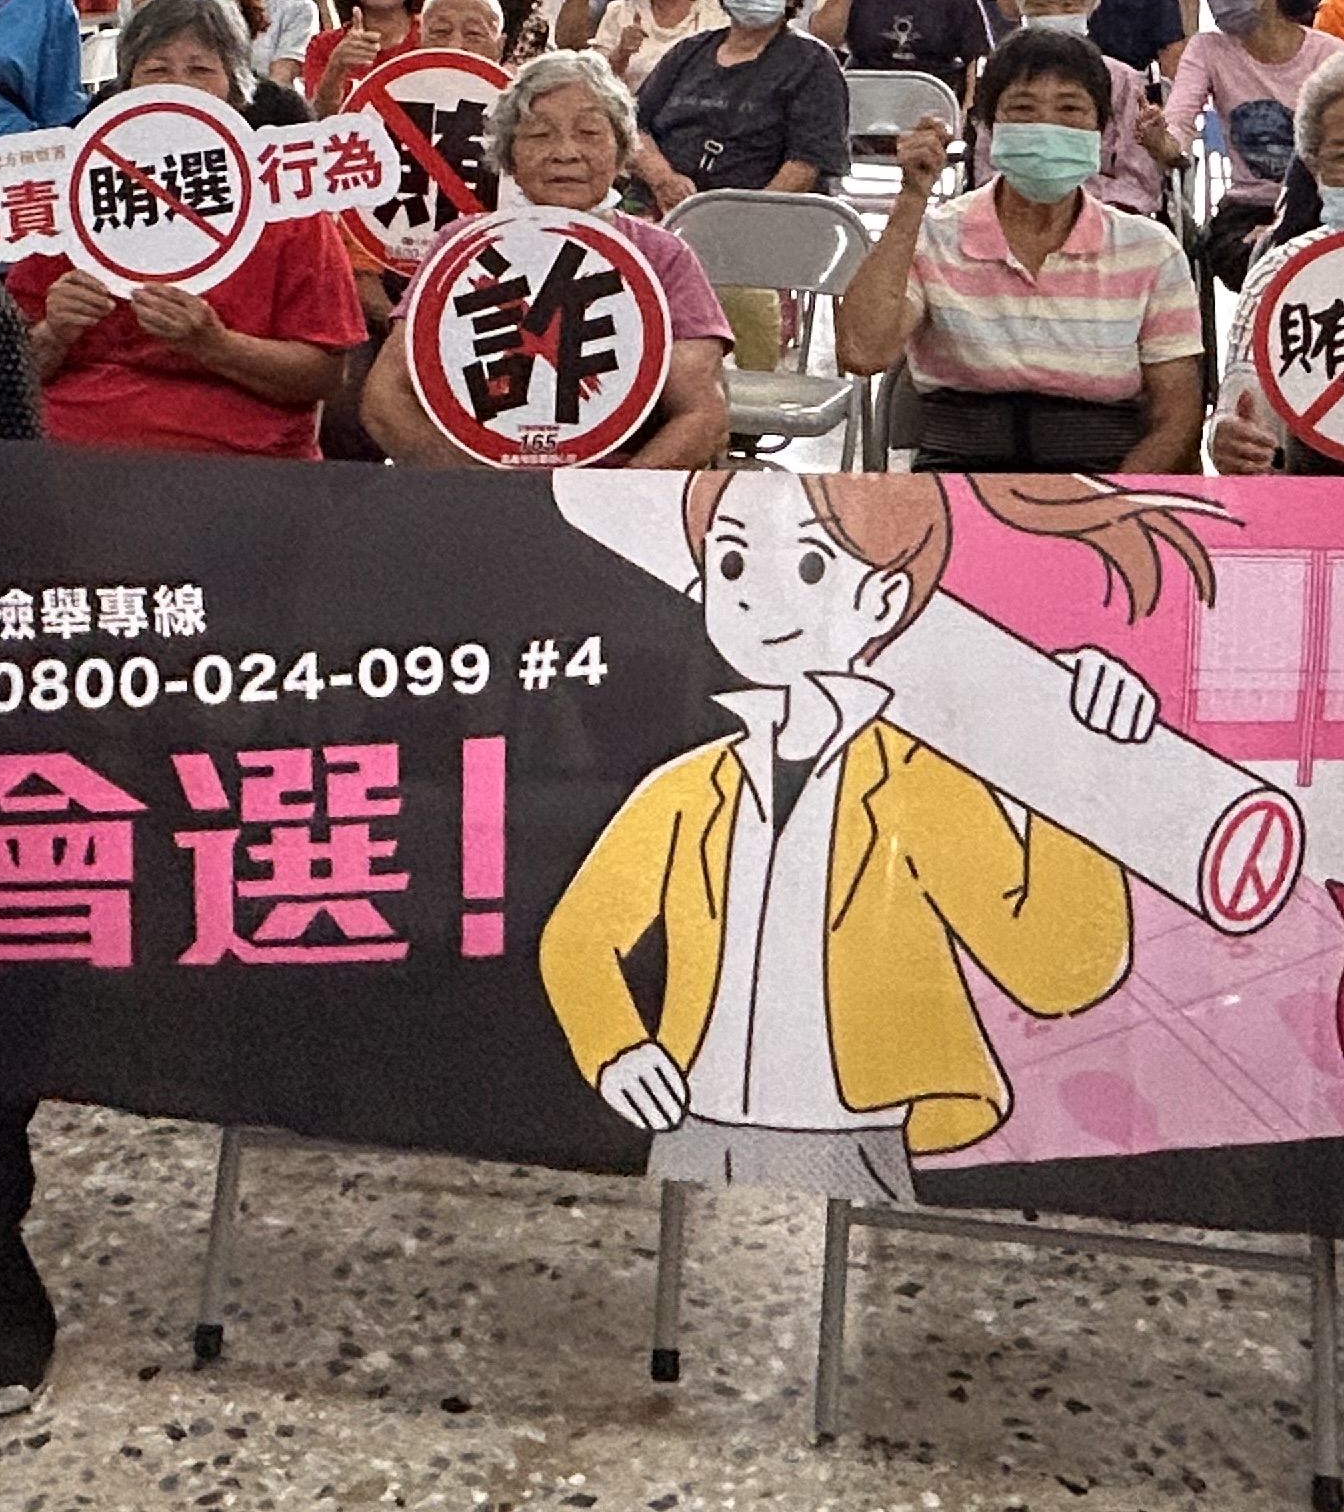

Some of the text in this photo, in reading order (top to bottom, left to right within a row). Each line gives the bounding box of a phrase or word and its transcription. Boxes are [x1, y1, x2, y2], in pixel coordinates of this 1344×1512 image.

[89, 147, 235, 233] 賄選
[257, 131, 382, 204] 行為
[453, 240, 625, 425] 詐
[521, 434, 557, 451] 165
[519, 636, 608, 690] #4
